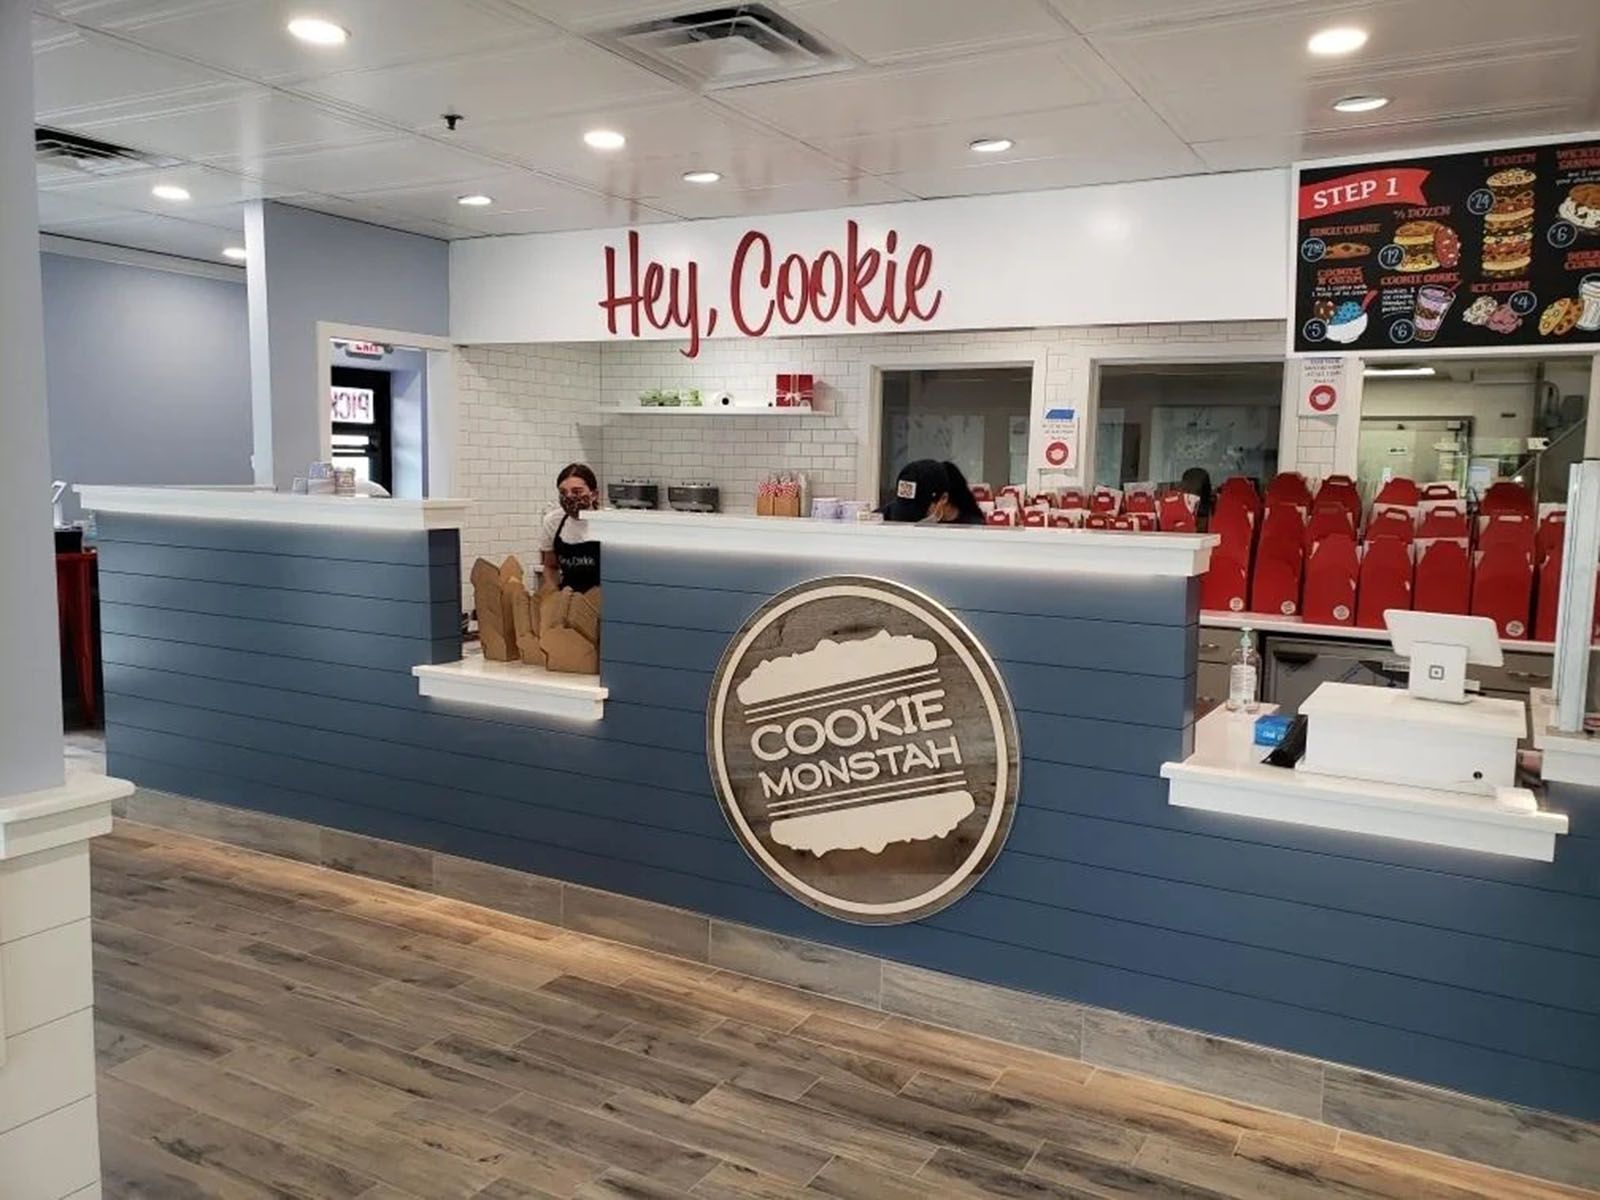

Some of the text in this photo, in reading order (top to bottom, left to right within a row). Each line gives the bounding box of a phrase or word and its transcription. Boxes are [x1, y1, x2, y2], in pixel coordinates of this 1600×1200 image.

[1313, 177, 1399, 209] STEP 1
[598, 219, 942, 358] Hey, Cookie
[751, 689, 953, 761] COOKIE
[758, 736, 962, 798] MONSTAH
